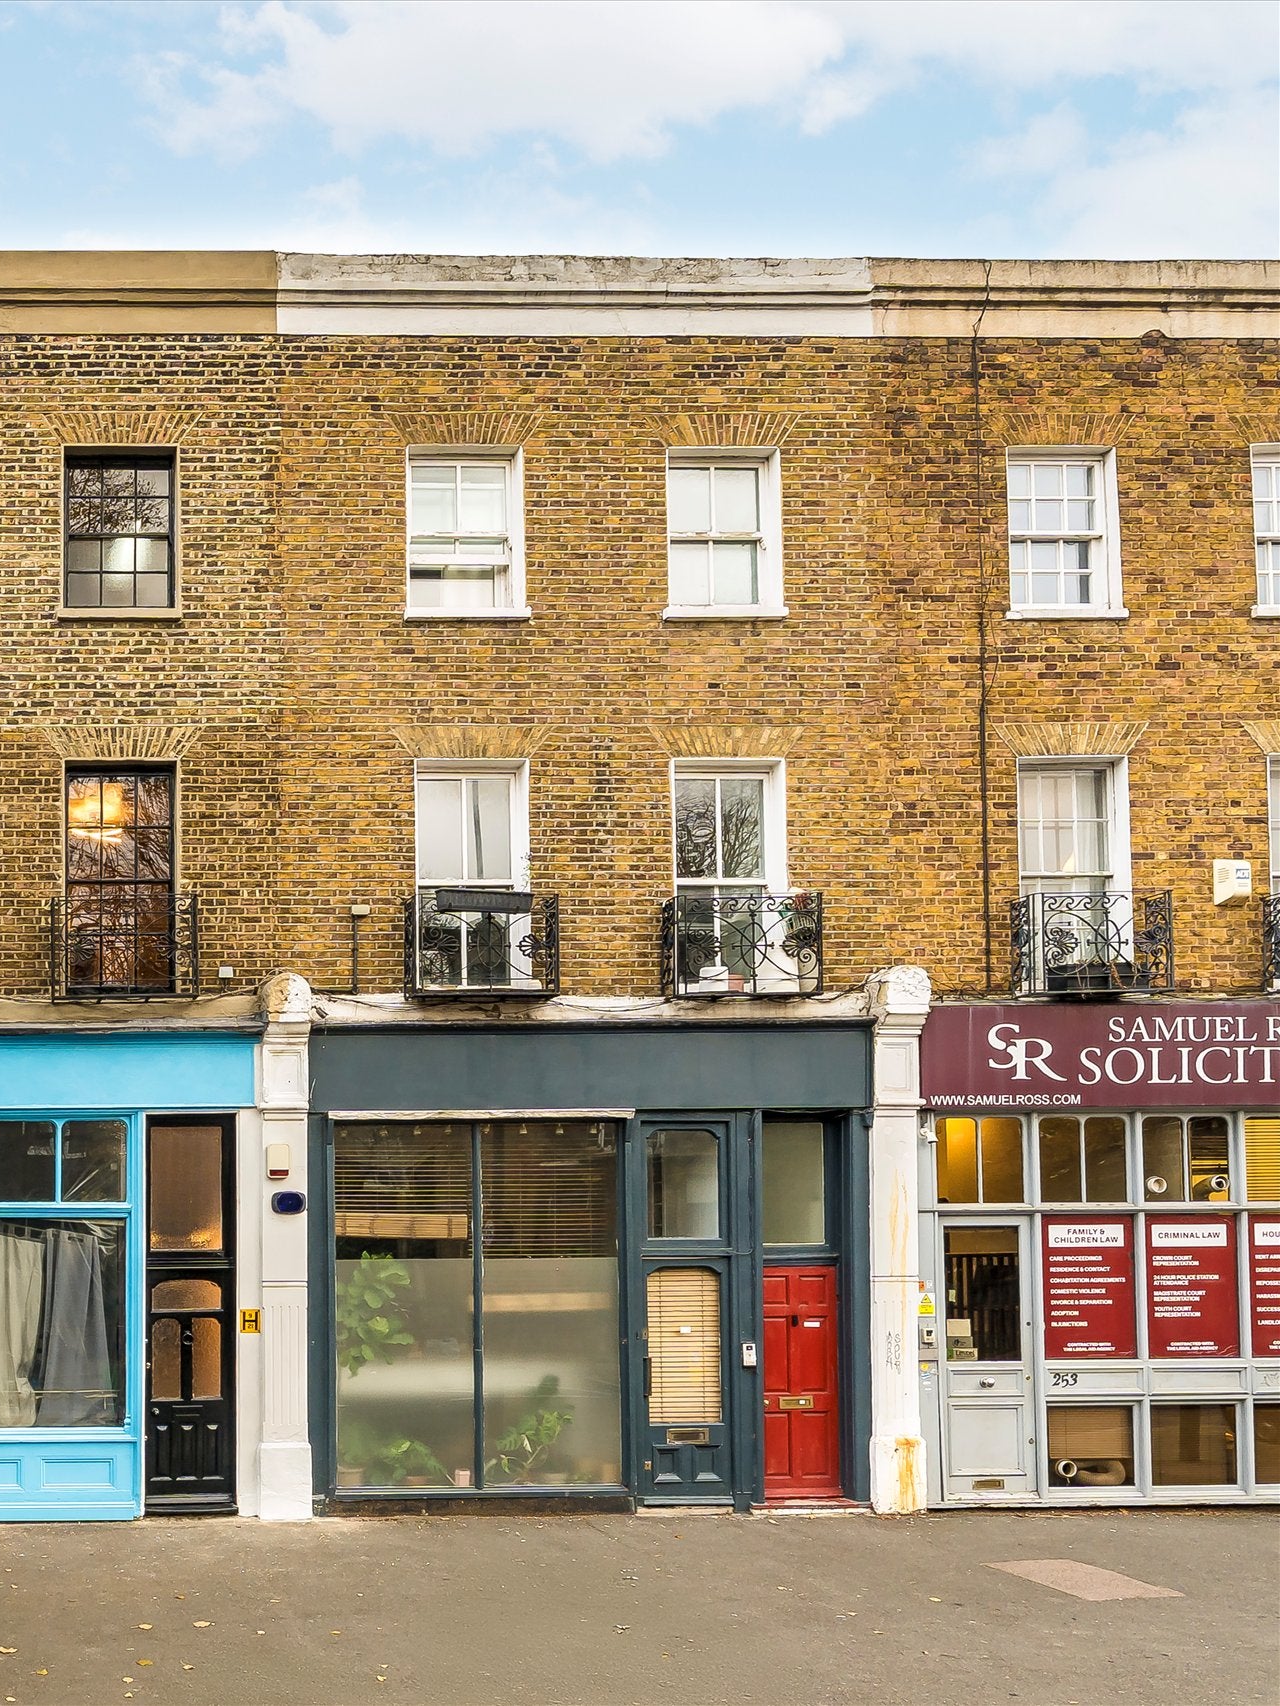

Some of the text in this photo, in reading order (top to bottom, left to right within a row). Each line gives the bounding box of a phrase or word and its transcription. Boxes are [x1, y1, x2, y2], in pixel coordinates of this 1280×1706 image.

[1108, 1016, 1258, 1042] SAMUEL
[987, 1023, 1068, 1082] SR
[1078, 1045, 1280, 1085] SOLICIT
[930, 1093, 1081, 1106] WWW.SAMUELROSS.COM
[242, 1311, 258, 1331] H
[1051, 1372, 1079, 1389] 253
